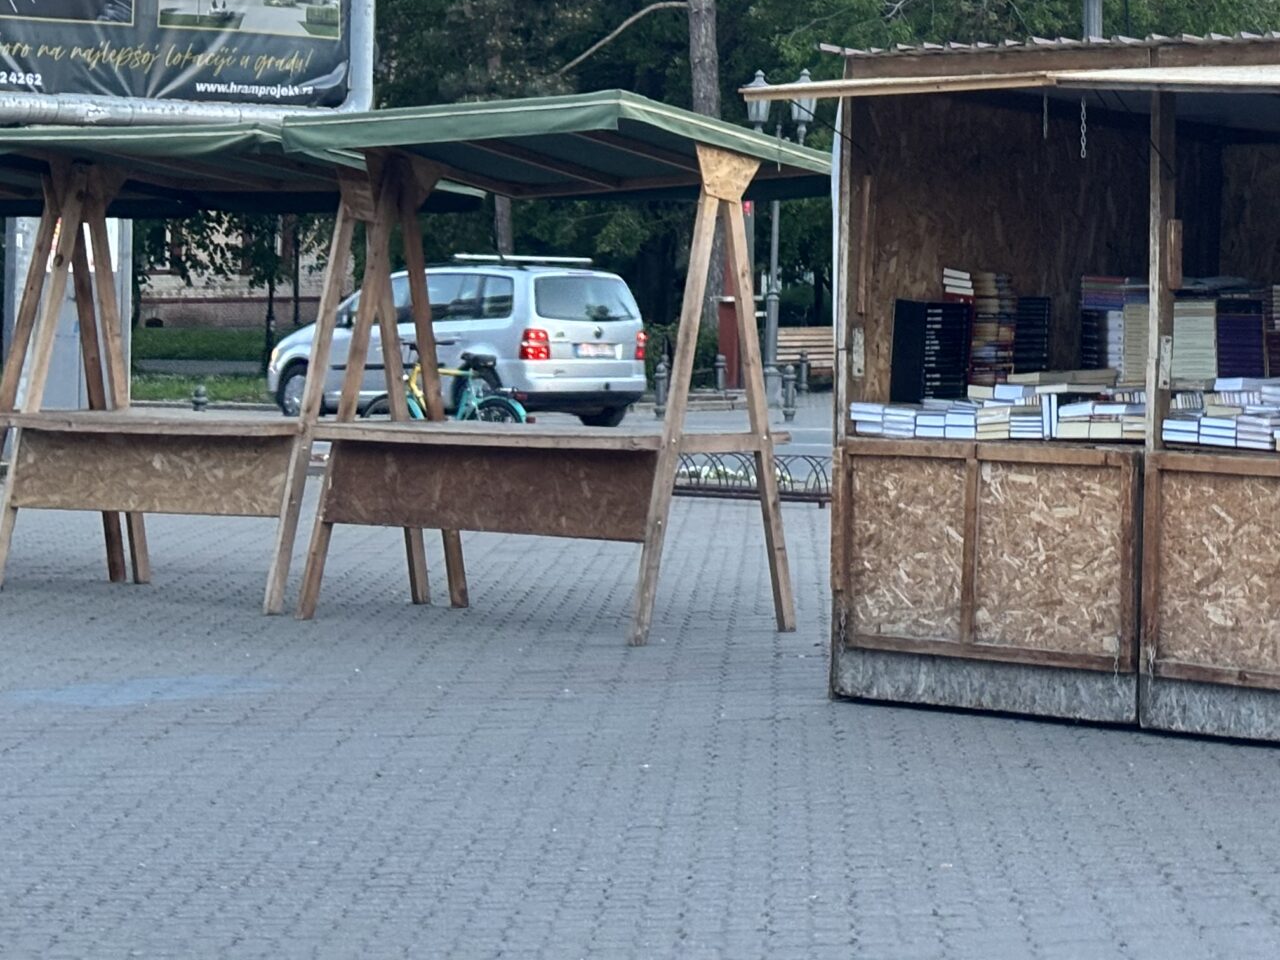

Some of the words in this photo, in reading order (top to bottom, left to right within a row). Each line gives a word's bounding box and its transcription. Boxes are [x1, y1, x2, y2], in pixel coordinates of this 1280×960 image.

[0, 42, 31, 58] oro
[37, 44, 66, 61] na
[70, 40, 160, 75] najlepšoj
[165, 43, 238, 77] lokaciji
[239, 58, 249, 69] u
[254, 47, 314, 80] gradu!
[0, 71, 43, 86] 24262
